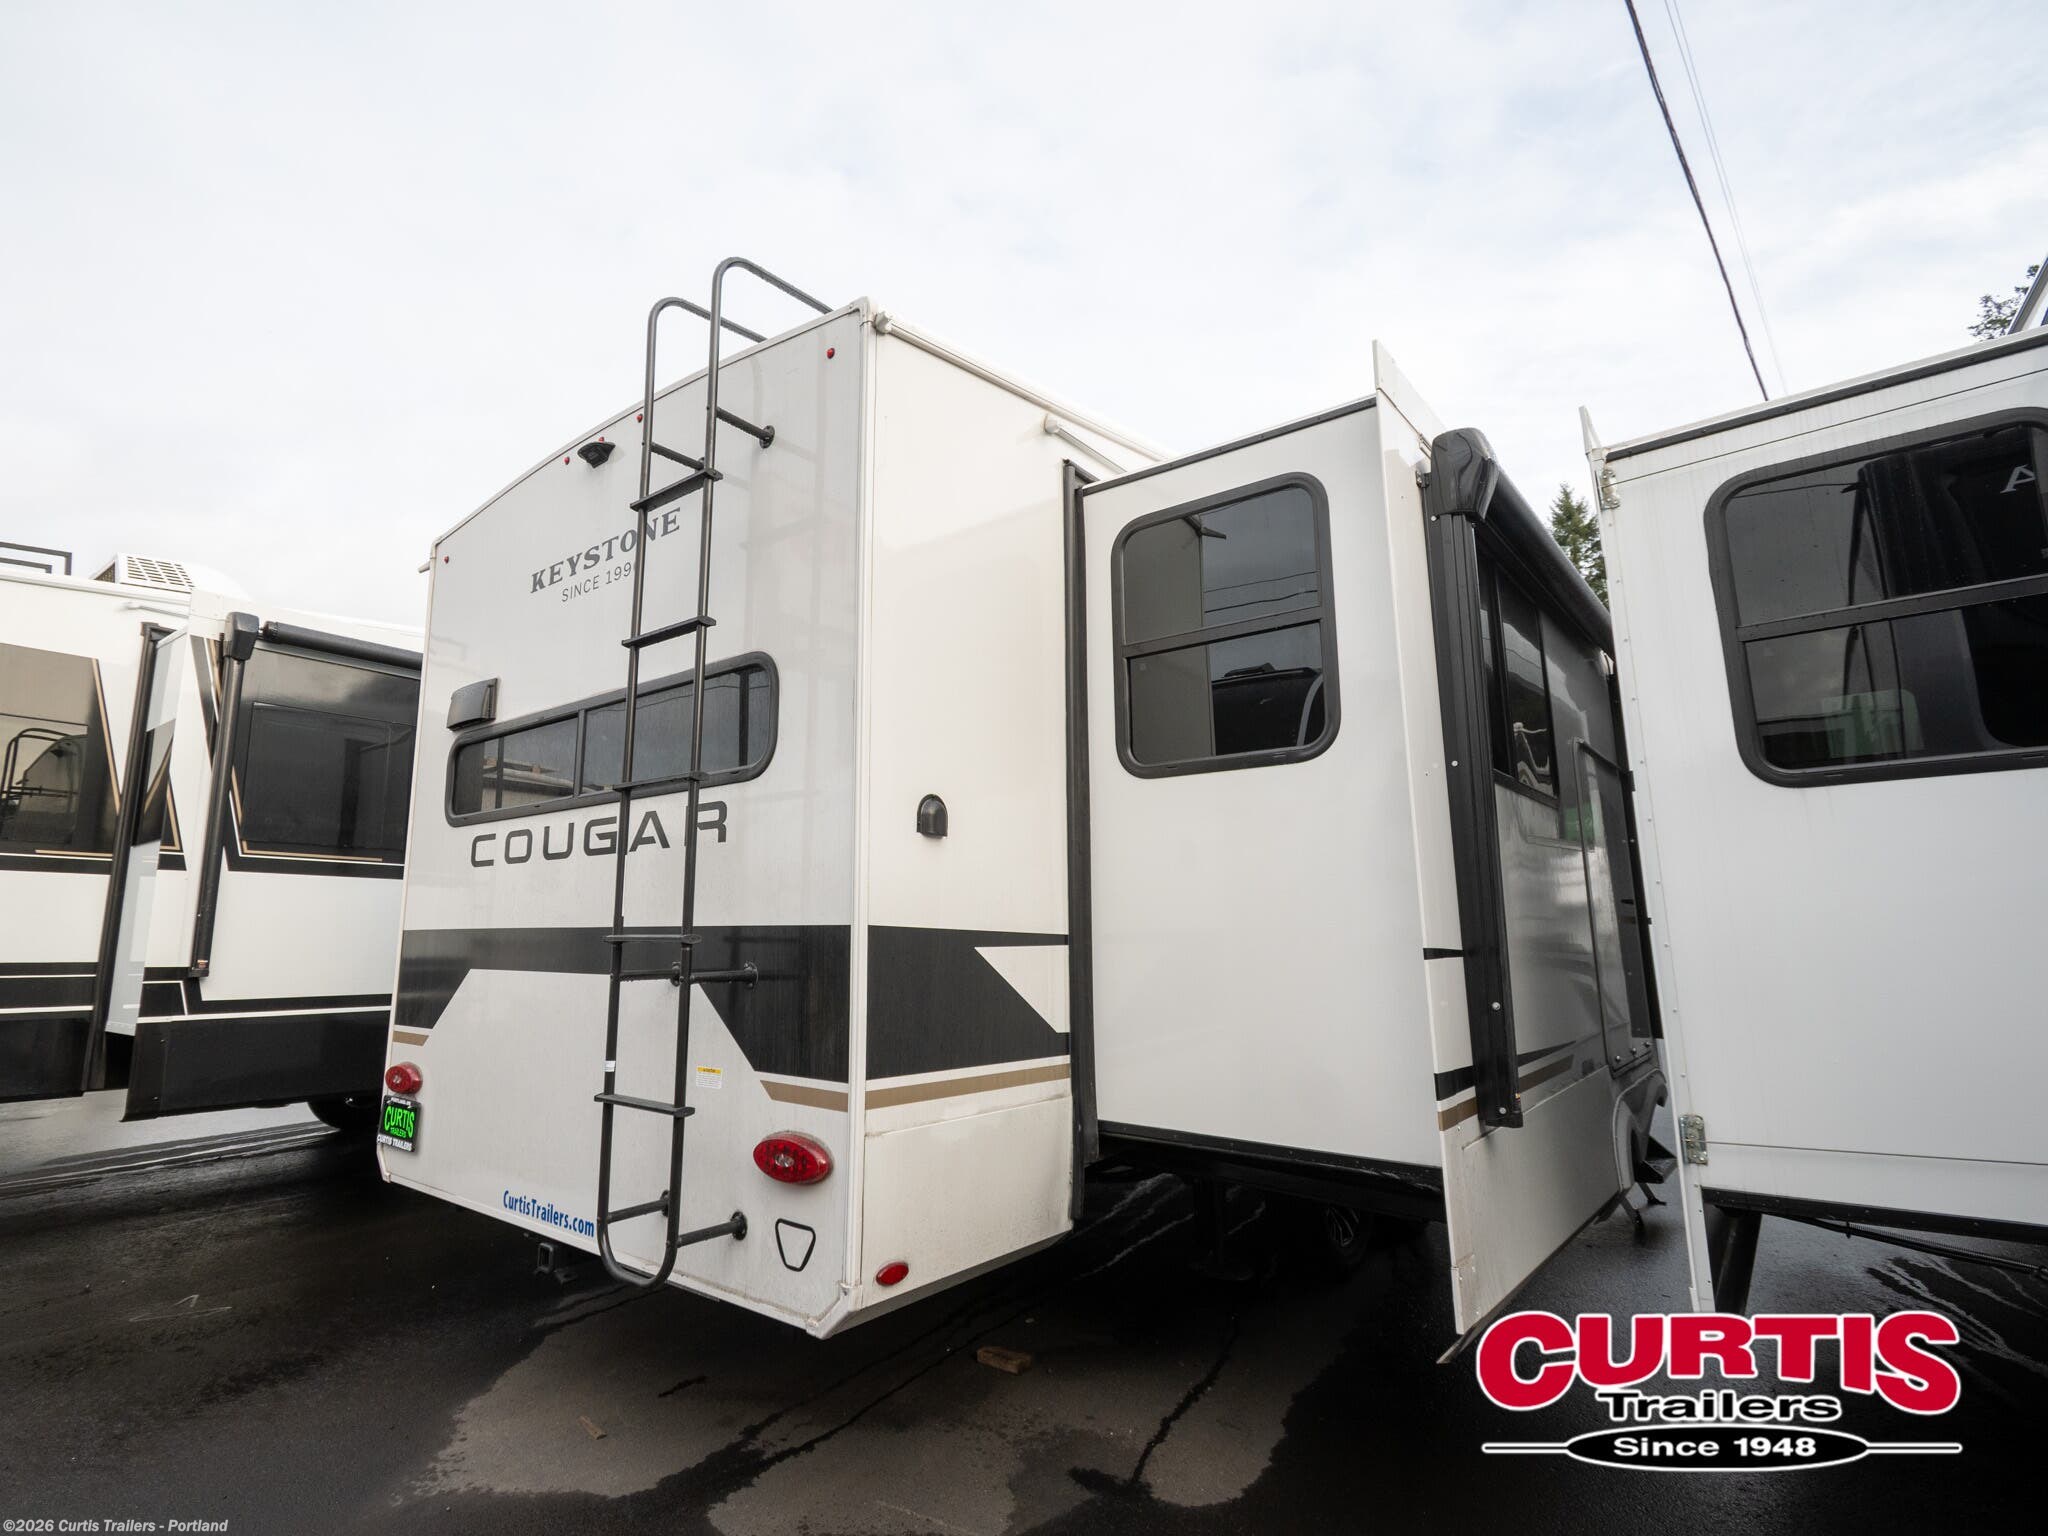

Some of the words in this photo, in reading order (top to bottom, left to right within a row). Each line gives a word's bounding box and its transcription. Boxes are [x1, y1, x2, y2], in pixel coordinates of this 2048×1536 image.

[530, 507, 681, 593] KEYSTONE
[561, 573, 600, 602] SINCE
[605, 557, 636, 585] 199
[471, 801, 727, 867] COUGAR
[384, 1106, 415, 1138] CURTIS
[503, 1190, 595, 1237] CurtisTrailers.com
